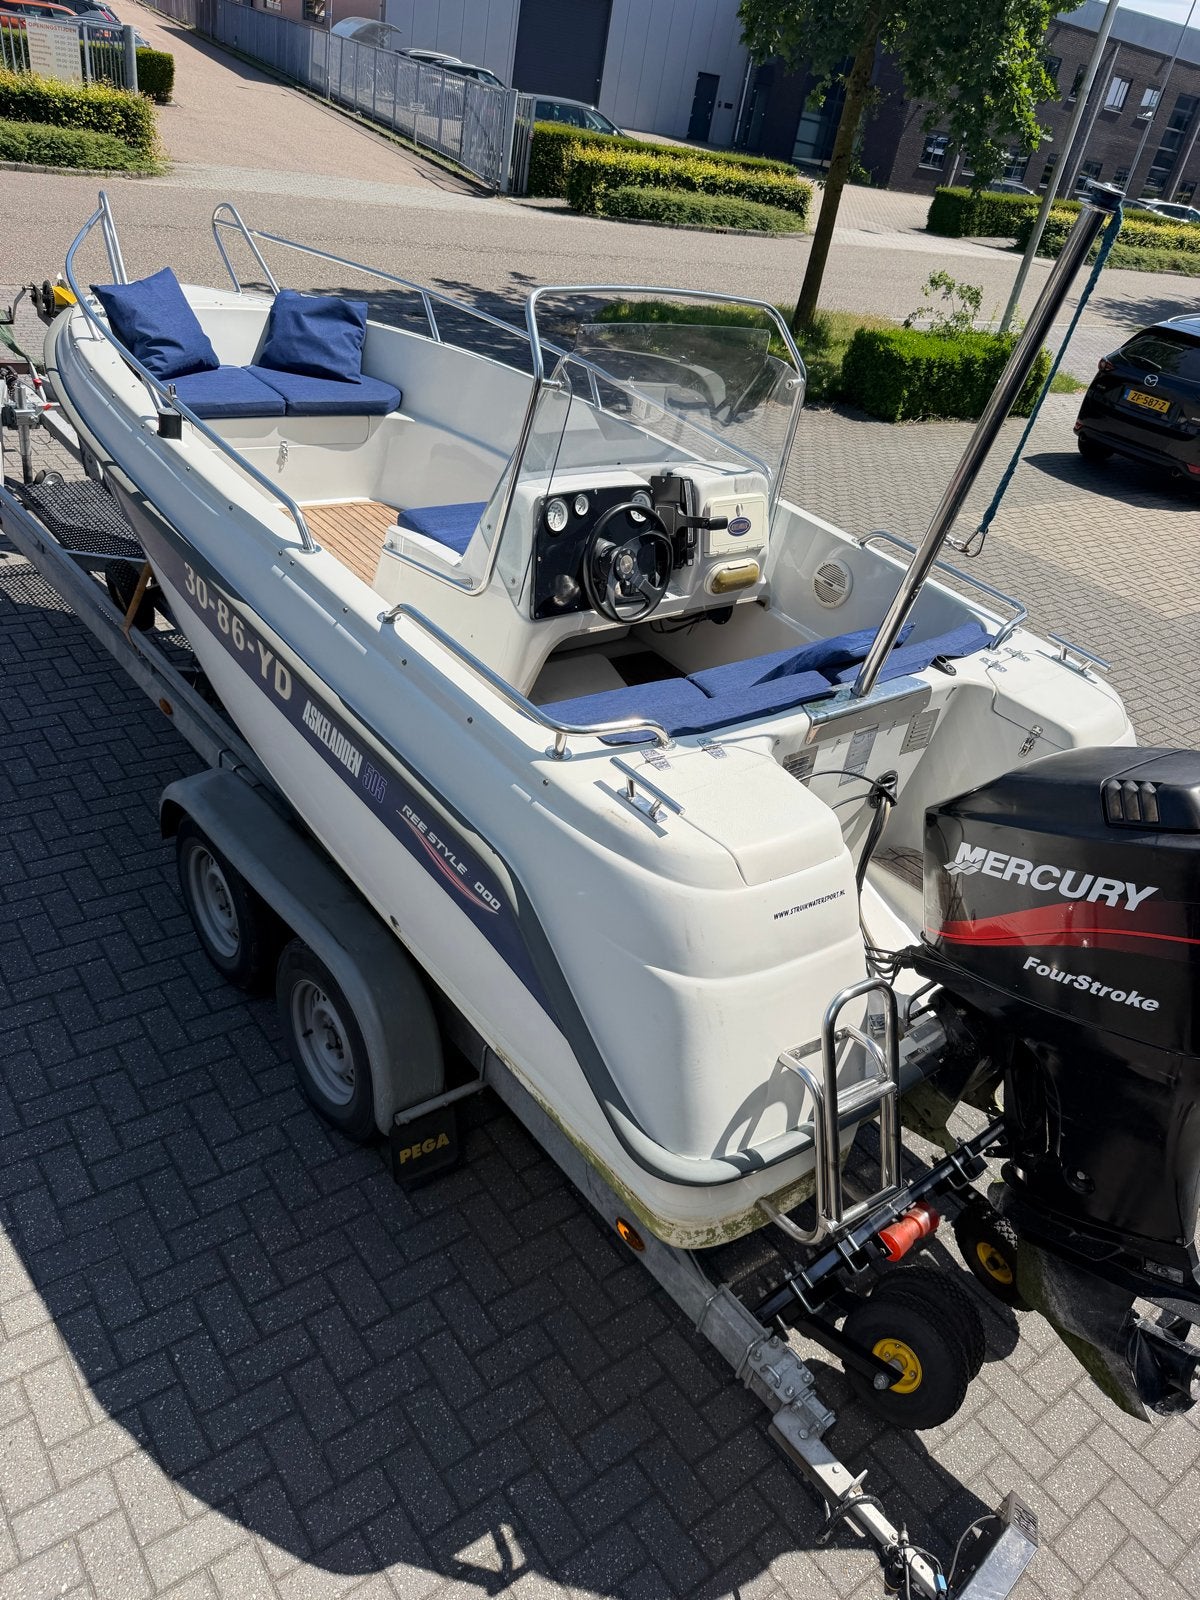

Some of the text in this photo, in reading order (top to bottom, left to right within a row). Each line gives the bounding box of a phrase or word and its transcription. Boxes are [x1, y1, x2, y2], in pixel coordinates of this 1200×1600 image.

[28, 22, 77, 33] OPENINGSTIJDEN
[1131, 392, 1167, 411] ZF-587-Z
[184, 562, 292, 701] 30-86-YD
[302, 700, 387, 803] ASKELADDEN 505
[402, 805, 428, 833] REE
[427, 831, 468, 875] STYLE
[950, 842, 1159, 912] MERCURY
[1022, 956, 1160, 1012] FourStroke
[399, 1132, 450, 1165] PEGA
